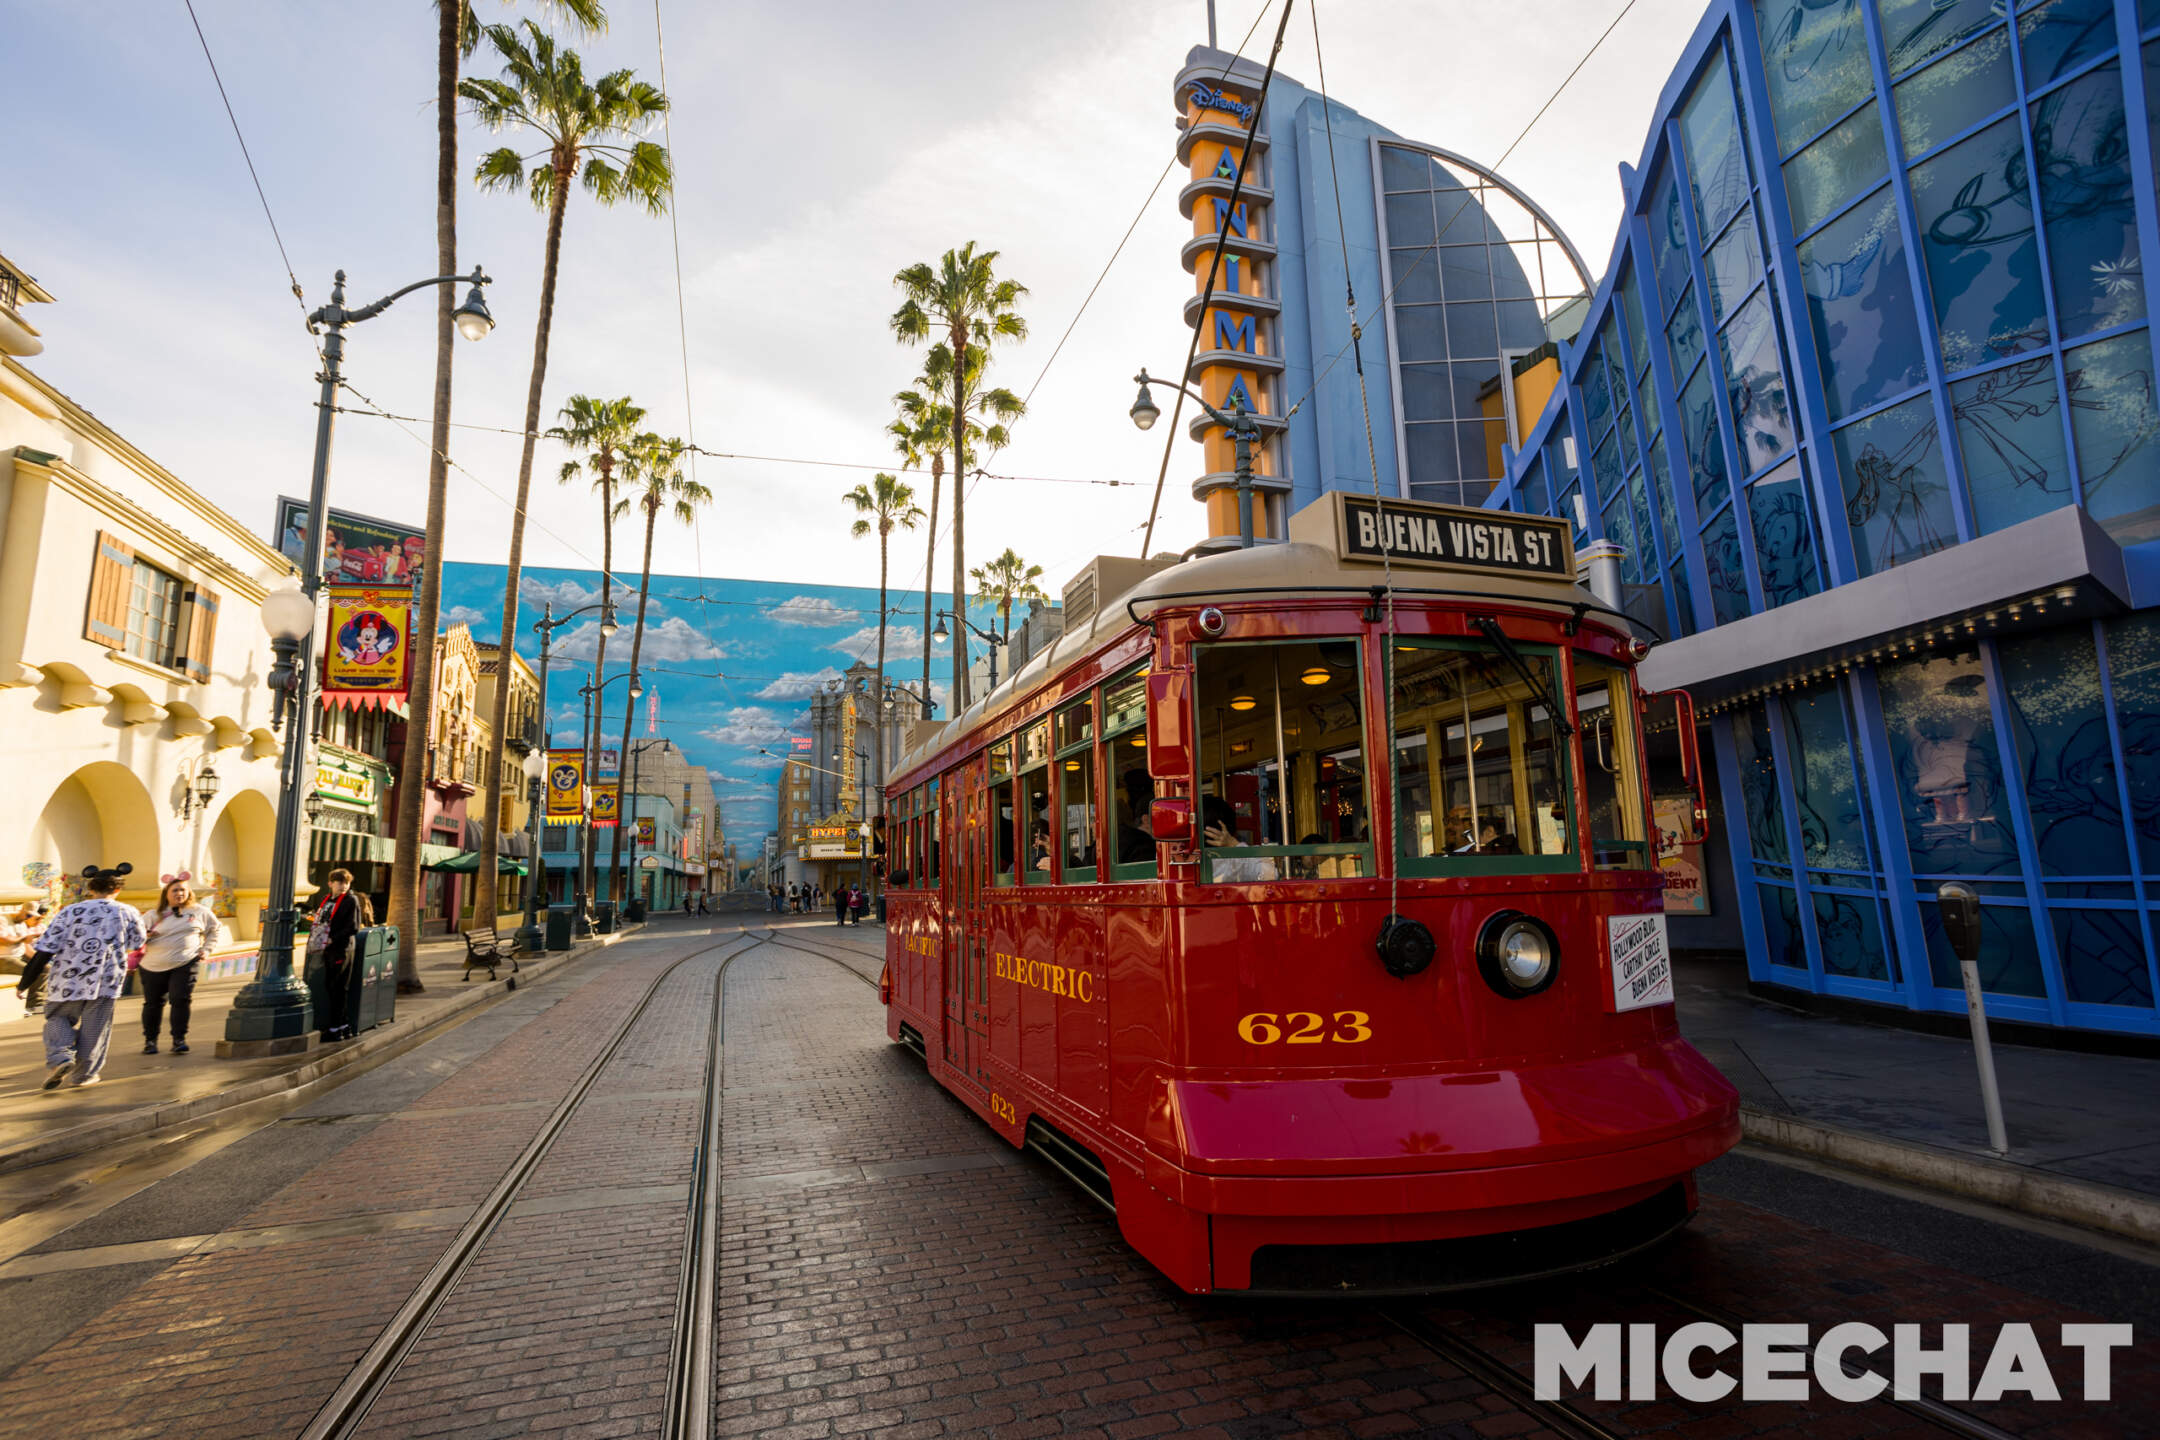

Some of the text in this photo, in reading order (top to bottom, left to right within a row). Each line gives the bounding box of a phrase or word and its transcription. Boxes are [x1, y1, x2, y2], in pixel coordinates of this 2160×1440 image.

[1211, 146, 1259, 470] ANIMA
[1357, 510, 1551, 566] BUENA VISTA ST
[1666, 878, 1698, 889] DEMY
[1614, 918, 1657, 962] HOLLYWOOD BLVD.
[1623, 937, 1660, 979] CARTHAY CIRCLE
[995, 952, 1093, 1004] ELECTRIC
[1632, 974, 1648, 999] BUENA
[1647, 962, 1661, 986] VISTA
[1238, 1010, 1372, 1045] 623
[992, 1092, 1015, 1125] 623
